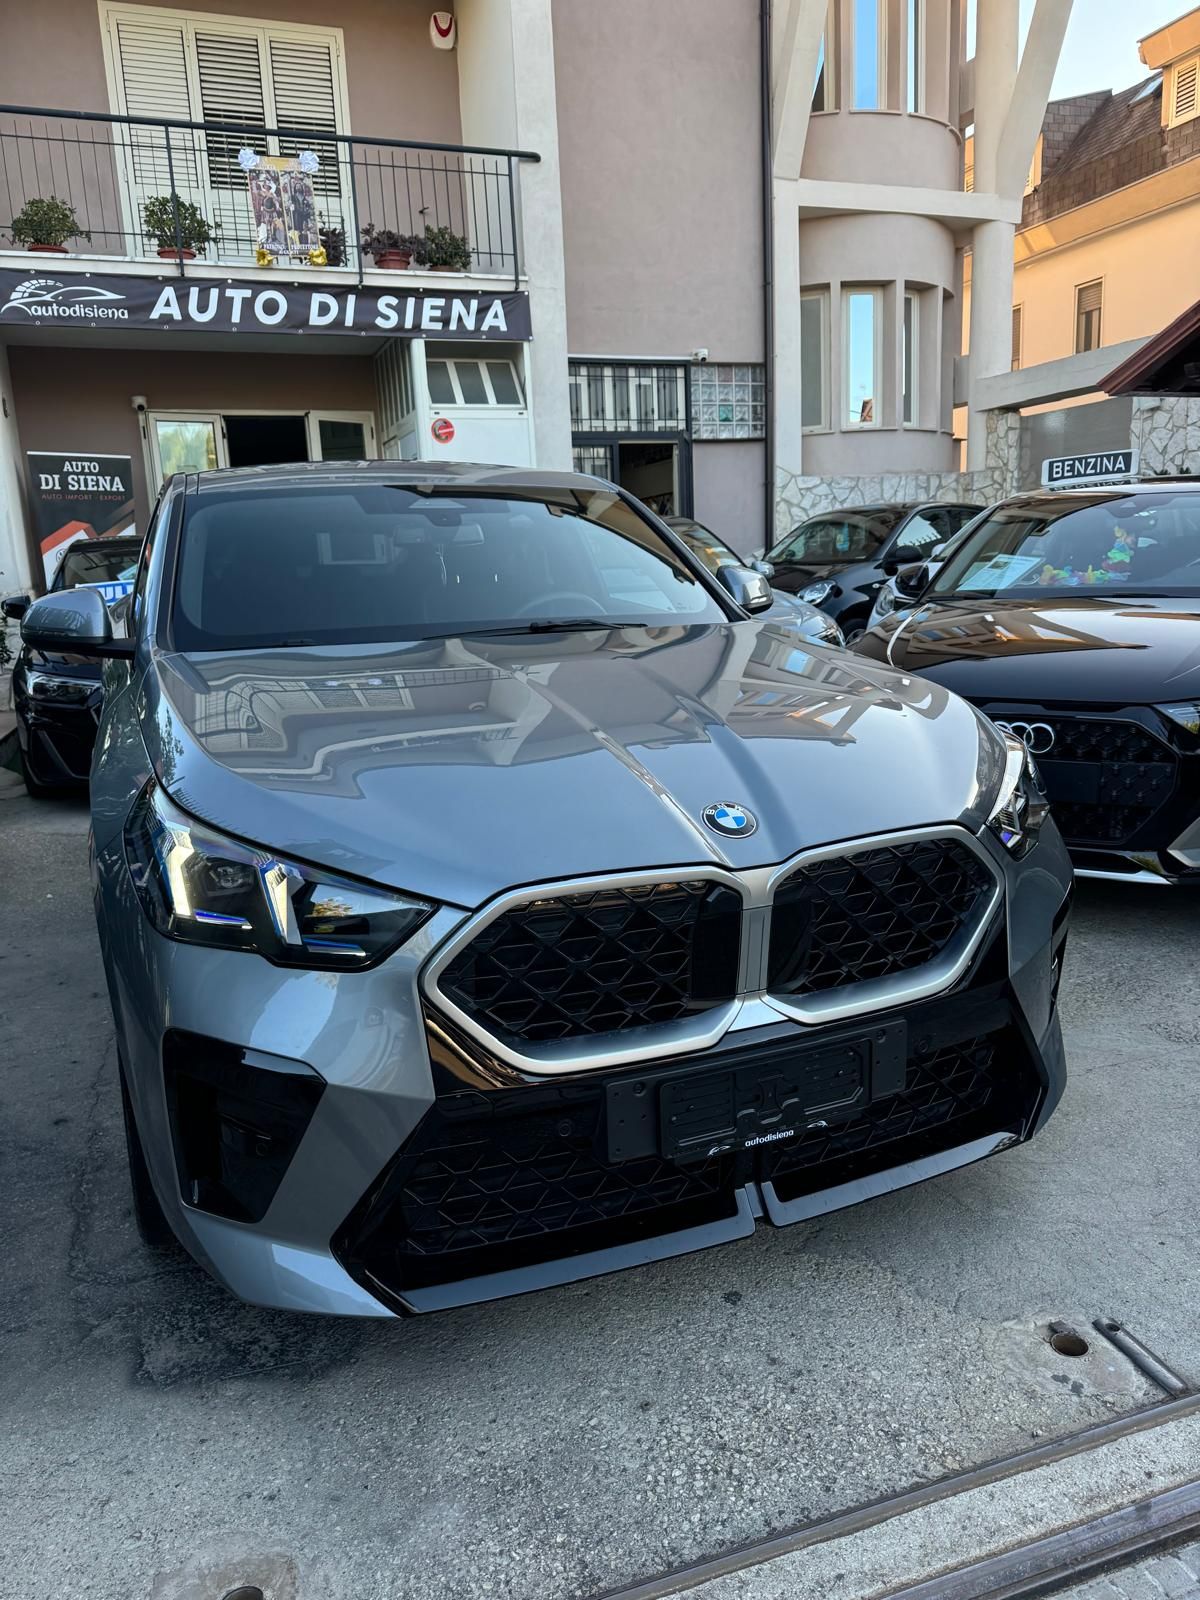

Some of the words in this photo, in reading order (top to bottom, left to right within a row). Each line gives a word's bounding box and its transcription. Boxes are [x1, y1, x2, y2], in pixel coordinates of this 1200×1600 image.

[31, 302, 129, 320] autodisiena
[149, 285, 289, 326] AUTO
[308, 292, 356, 328] DI
[374, 295, 508, 333] SIENA
[62, 461, 99, 473] AUTO
[1052, 455, 1126, 479] BENZINA
[39, 474, 61, 490] DI
[67, 474, 125, 492] SIENA
[745, 1129, 795, 1147] autodisiena
